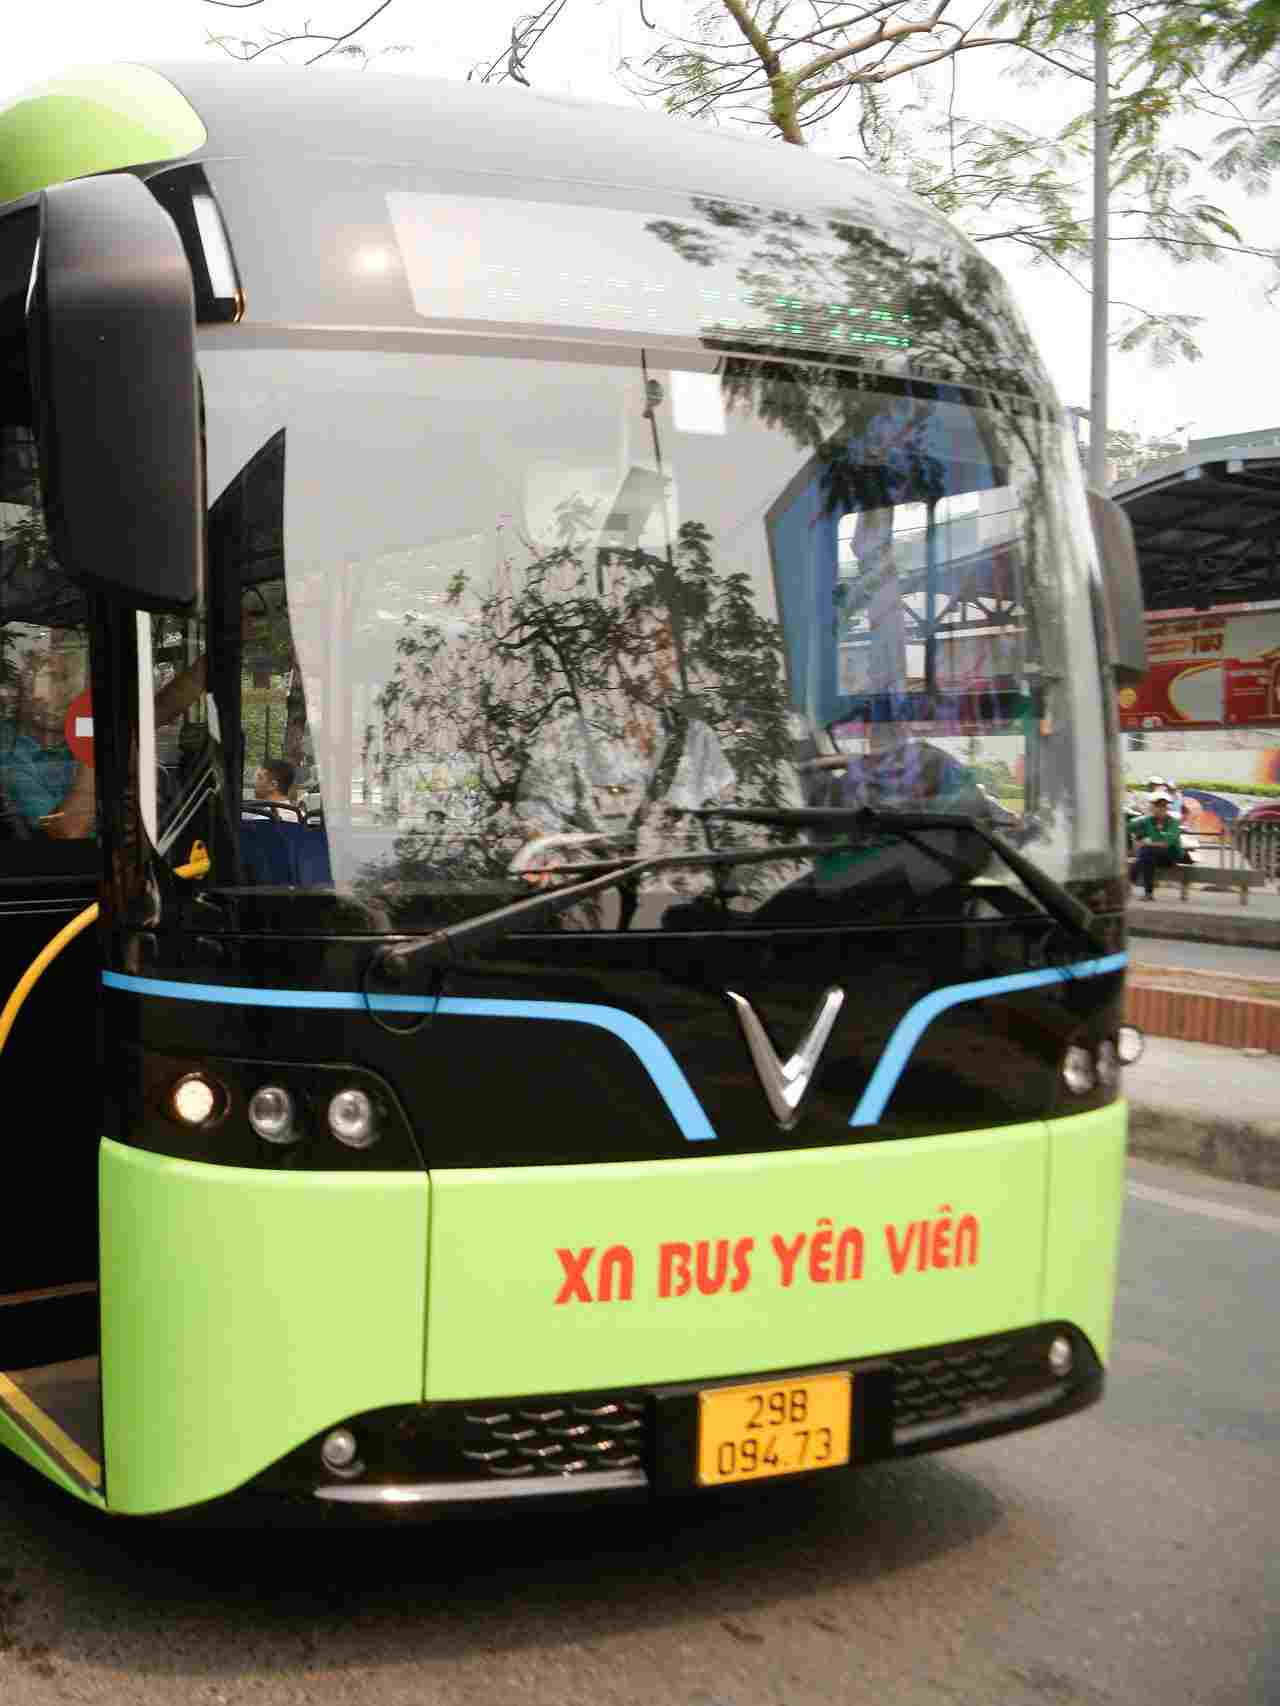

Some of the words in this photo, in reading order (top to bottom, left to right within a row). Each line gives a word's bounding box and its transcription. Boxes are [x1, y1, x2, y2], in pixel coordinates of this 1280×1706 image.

[554, 1244, 635, 1305] XN
[657, 1235, 754, 1299] BUS
[771, 1216, 865, 1288] YÊN
[884, 1203, 980, 1276] VIÊN
[745, 1389, 809, 1430] 29B
[717, 1427, 834, 1478] 094.73
